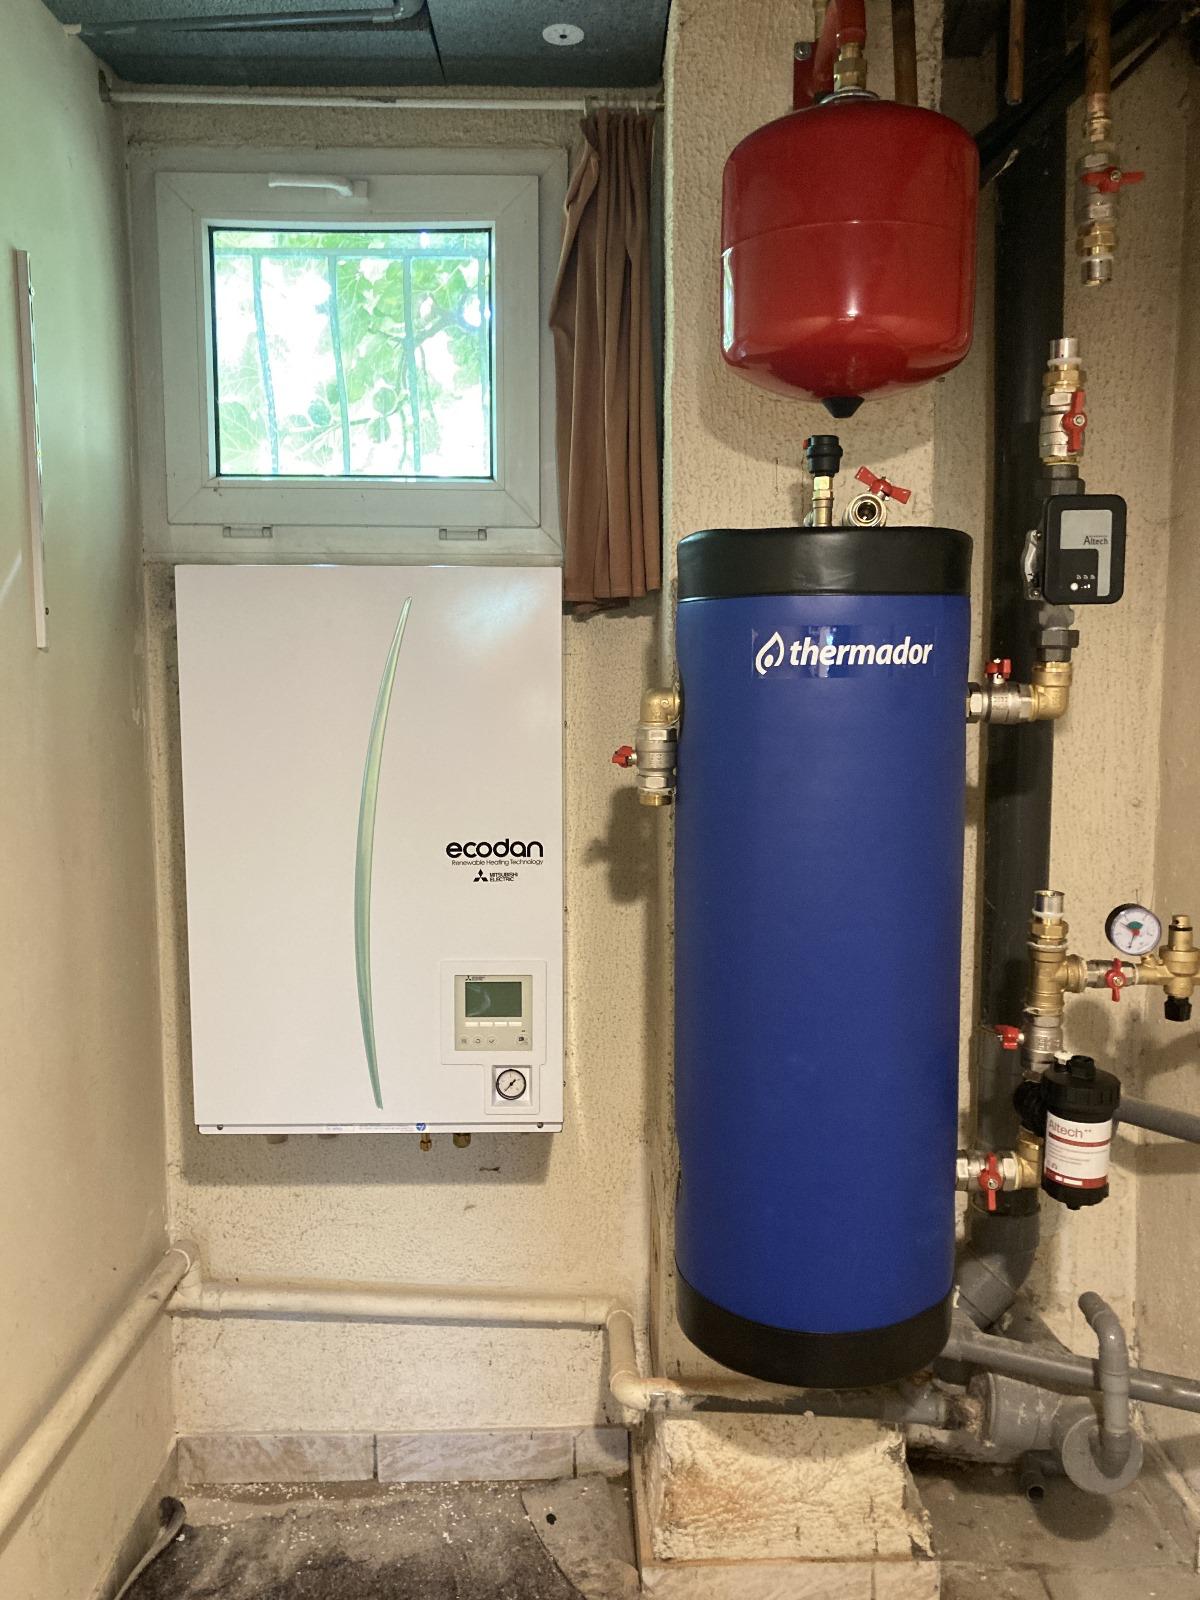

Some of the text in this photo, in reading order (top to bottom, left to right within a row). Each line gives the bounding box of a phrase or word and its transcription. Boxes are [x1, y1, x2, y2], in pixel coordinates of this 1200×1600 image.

[1083, 535, 1109, 546] Altech
[789, 636, 933, 666] thermador
[446, 838, 544, 858] ecodan
[510, 858, 544, 866] Technology
